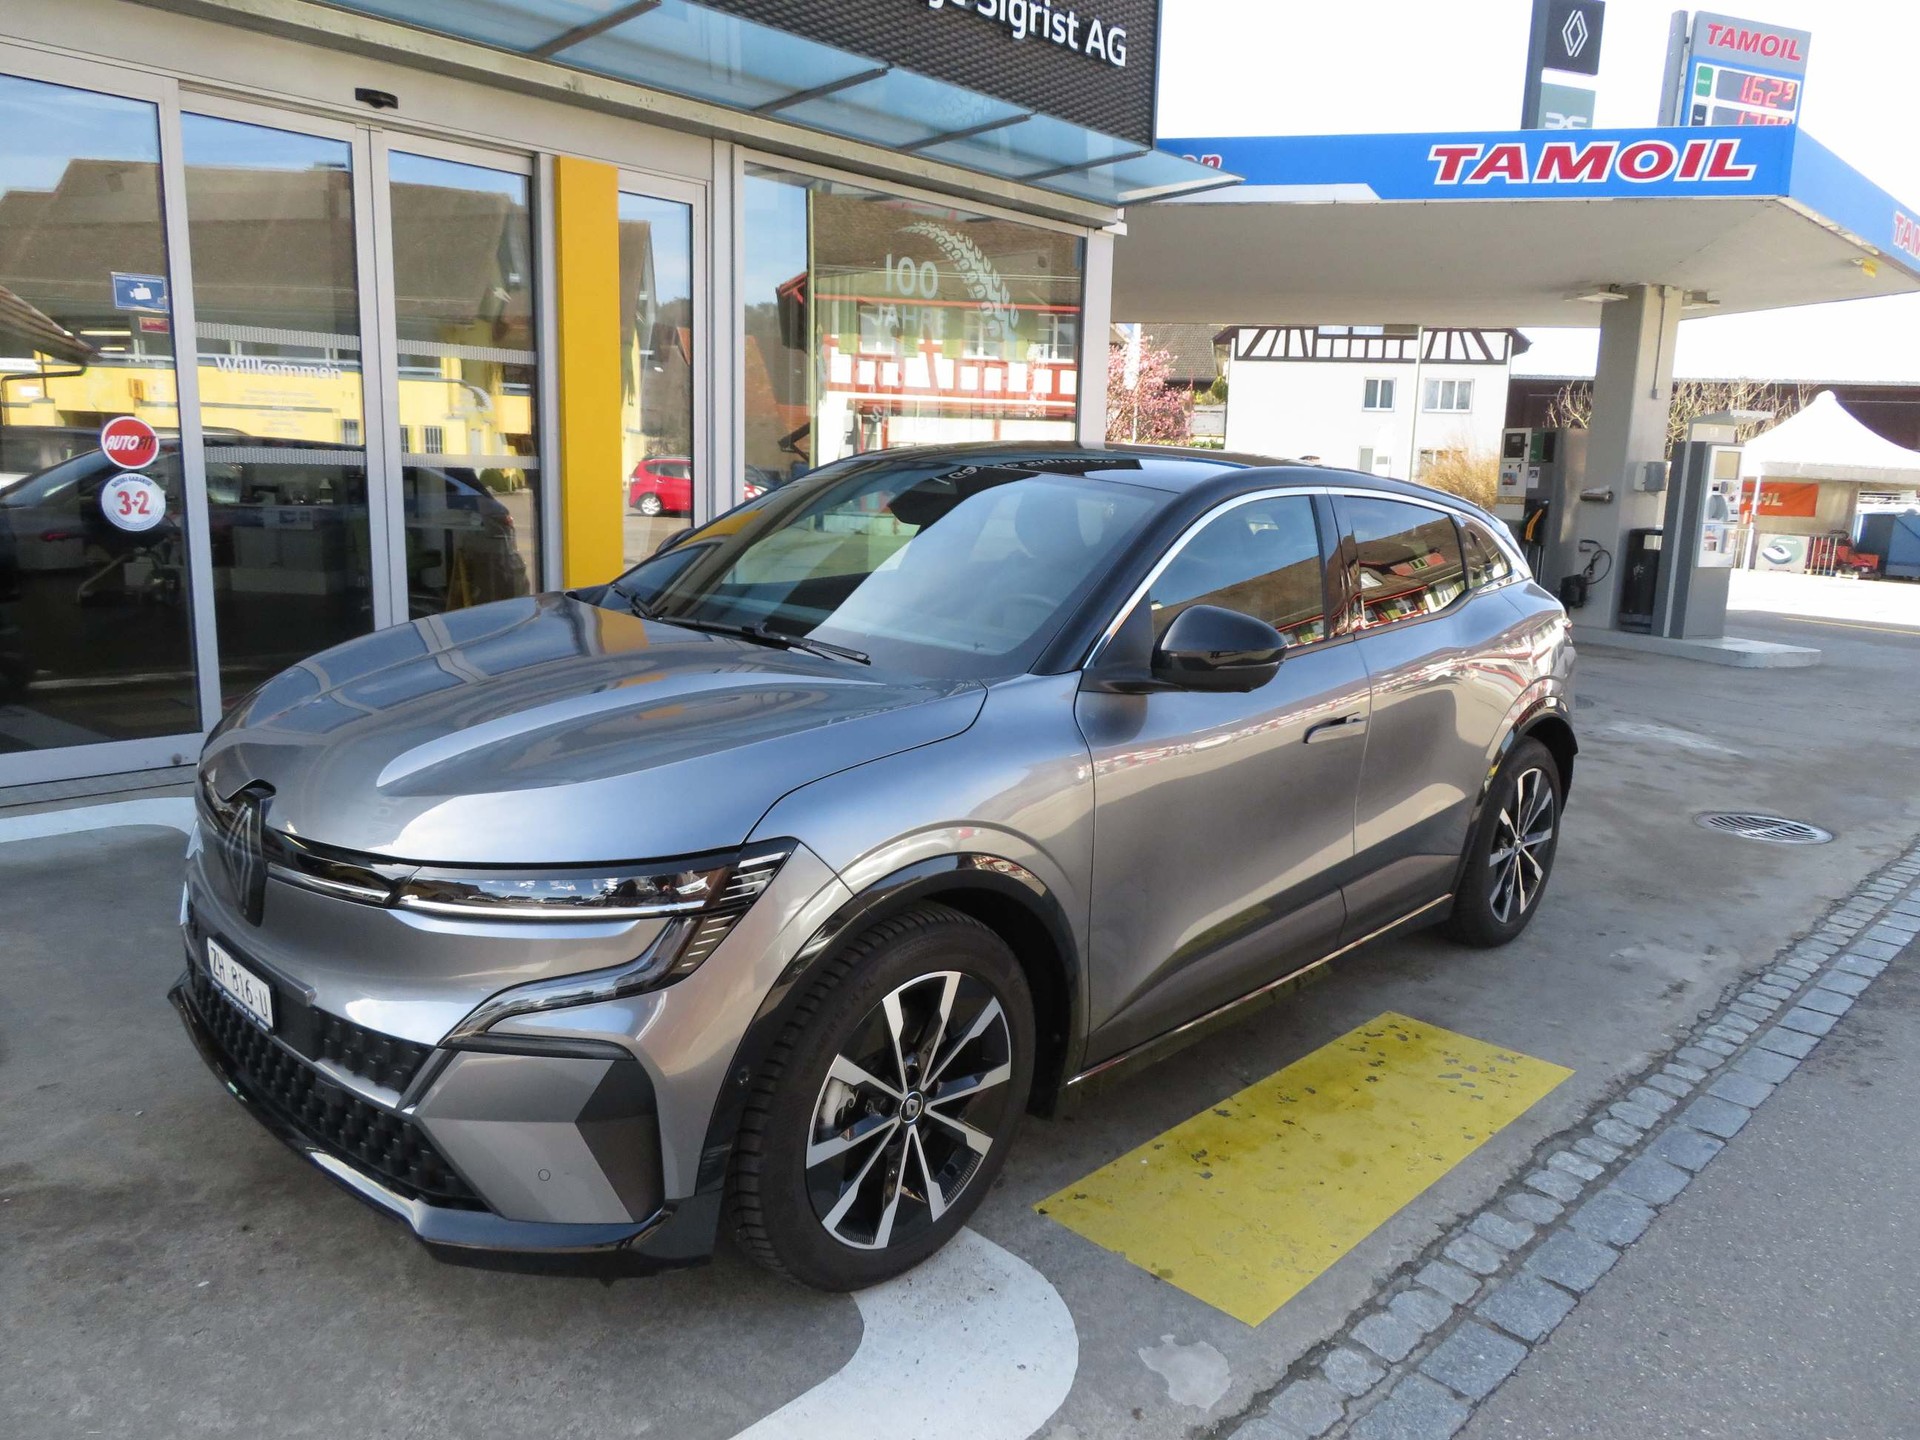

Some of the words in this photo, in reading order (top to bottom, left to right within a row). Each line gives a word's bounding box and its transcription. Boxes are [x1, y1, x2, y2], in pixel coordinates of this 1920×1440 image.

[1085, 18, 1126, 67] AG
[1707, 23, 1801, 61] TAMOIL
[1428, 139, 1757, 184] TAMOIL
[885, 253, 938, 299] 100
[871, 304, 947, 335] JAHRE
[215, 356, 341, 380] Willkommen
[117, 490, 151, 515] 3+2
[210, 946, 225, 982] ZH
